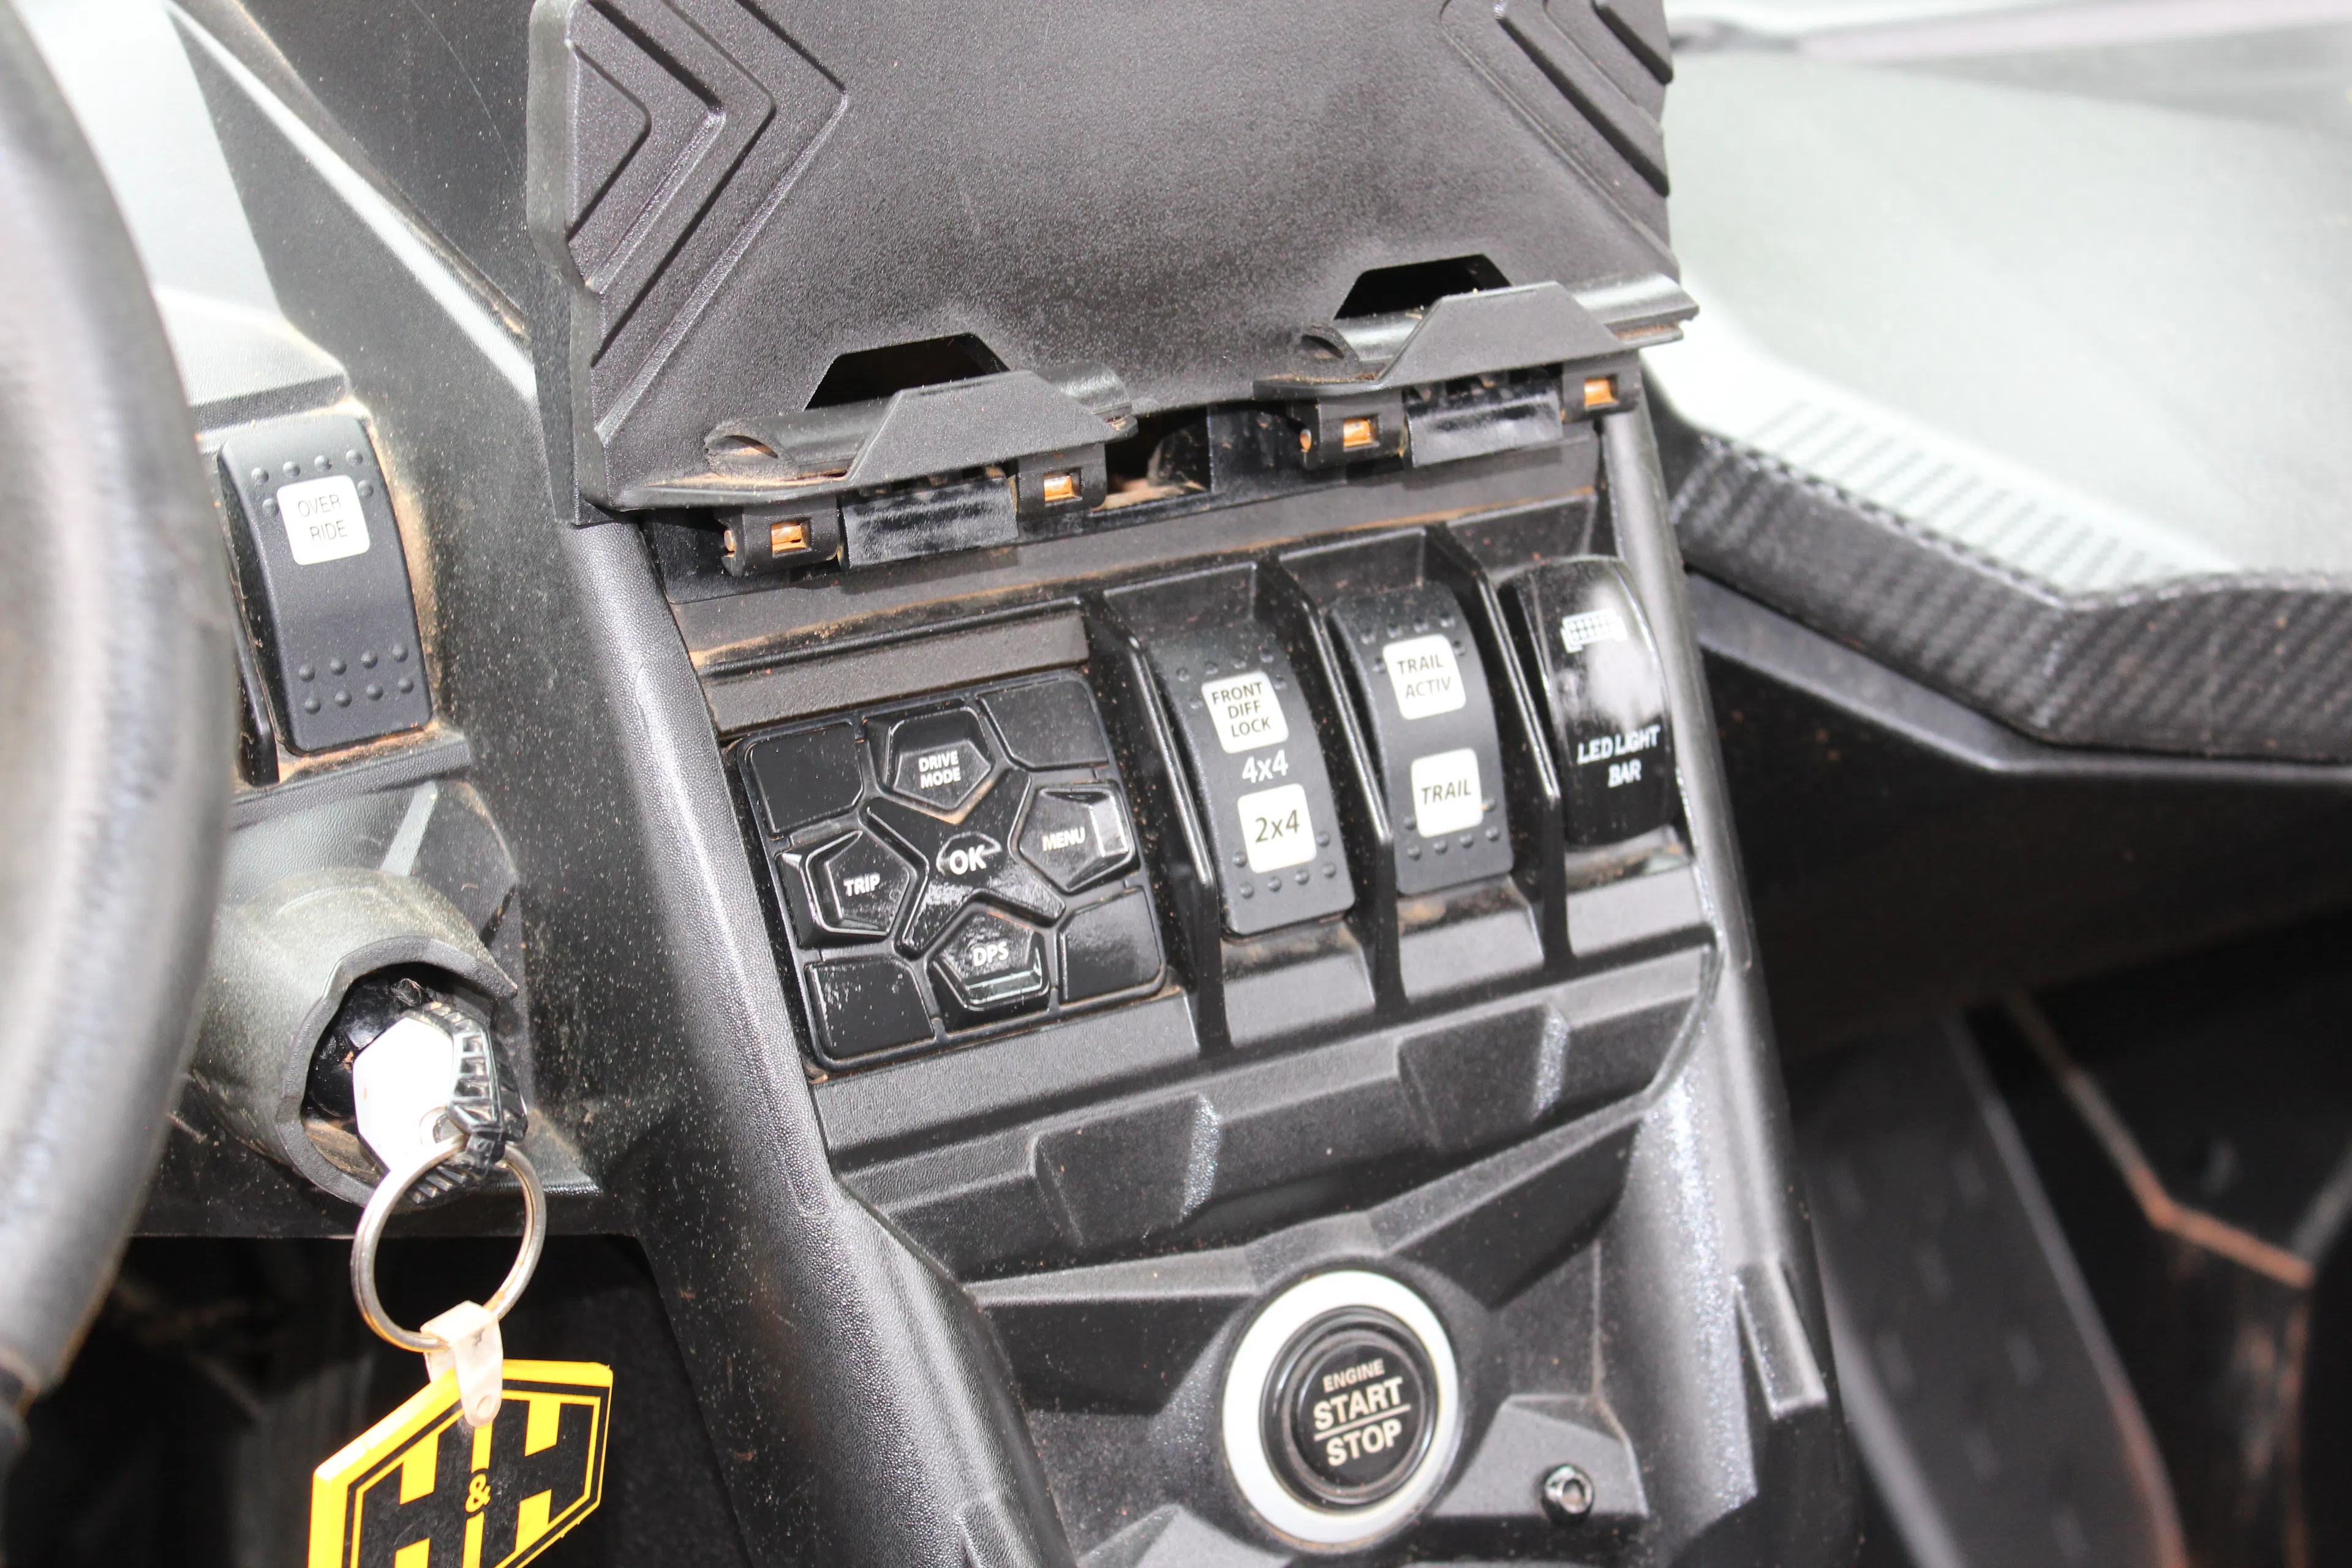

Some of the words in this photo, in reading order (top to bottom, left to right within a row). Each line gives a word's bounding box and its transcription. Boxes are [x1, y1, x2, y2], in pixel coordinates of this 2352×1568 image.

[298, 494, 341, 517] OVER
[310, 521, 347, 541] RIDE
[1397, 655, 1444, 674] TRAIL
[1212, 682, 1263, 704] FRONT
[1406, 677, 1452, 699] ACTIV
[1227, 701, 1262, 718] DIFF
[1231, 717, 1270, 737] LOCK
[1577, 737, 1613, 764] LED
[1615, 725, 1660, 754] LIGHT
[919, 752, 959, 772] DRIVE
[1242, 750, 1288, 783] 4x4
[1608, 760, 1642, 787] BAR
[921, 770, 961, 788] MODE
[1422, 779, 1471, 805] TRAIL
[1255, 810, 1300, 843] 2x4
[1043, 829, 1085, 851] MENU
[949, 845, 986, 875] OK
[843, 873, 880, 896] TRIP
[973, 944, 1009, 966] DPS
[1324, 1359, 1385, 1393] ENGINE
[1313, 1377, 1403, 1430] START
[1327, 1419, 1402, 1466] STOP
